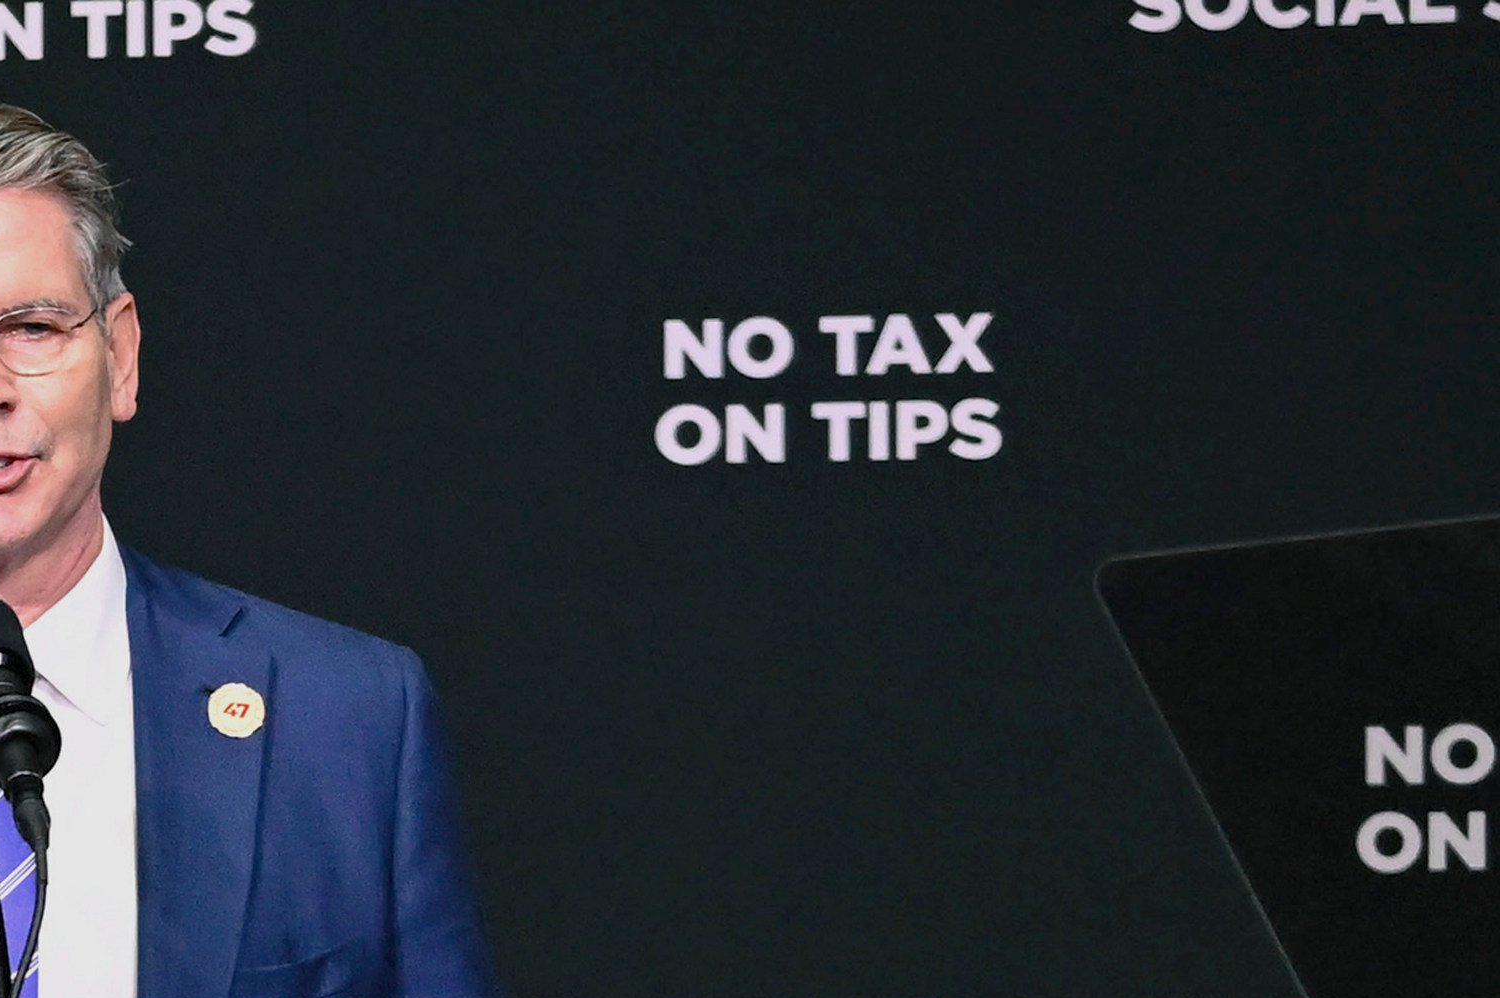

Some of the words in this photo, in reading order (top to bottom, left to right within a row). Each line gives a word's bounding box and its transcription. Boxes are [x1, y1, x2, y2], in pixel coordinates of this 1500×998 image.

[70, 0, 257, 59] TIPS
[663, 316, 795, 380] NO
[818, 312, 994, 376] TAX
[654, 403, 786, 466] ON
[810, 397, 1003, 462] TIPS
[223, 702, 250, 718] 47
[1365, 723, 1495, 785] NO
[1356, 810, 1486, 873] ON
